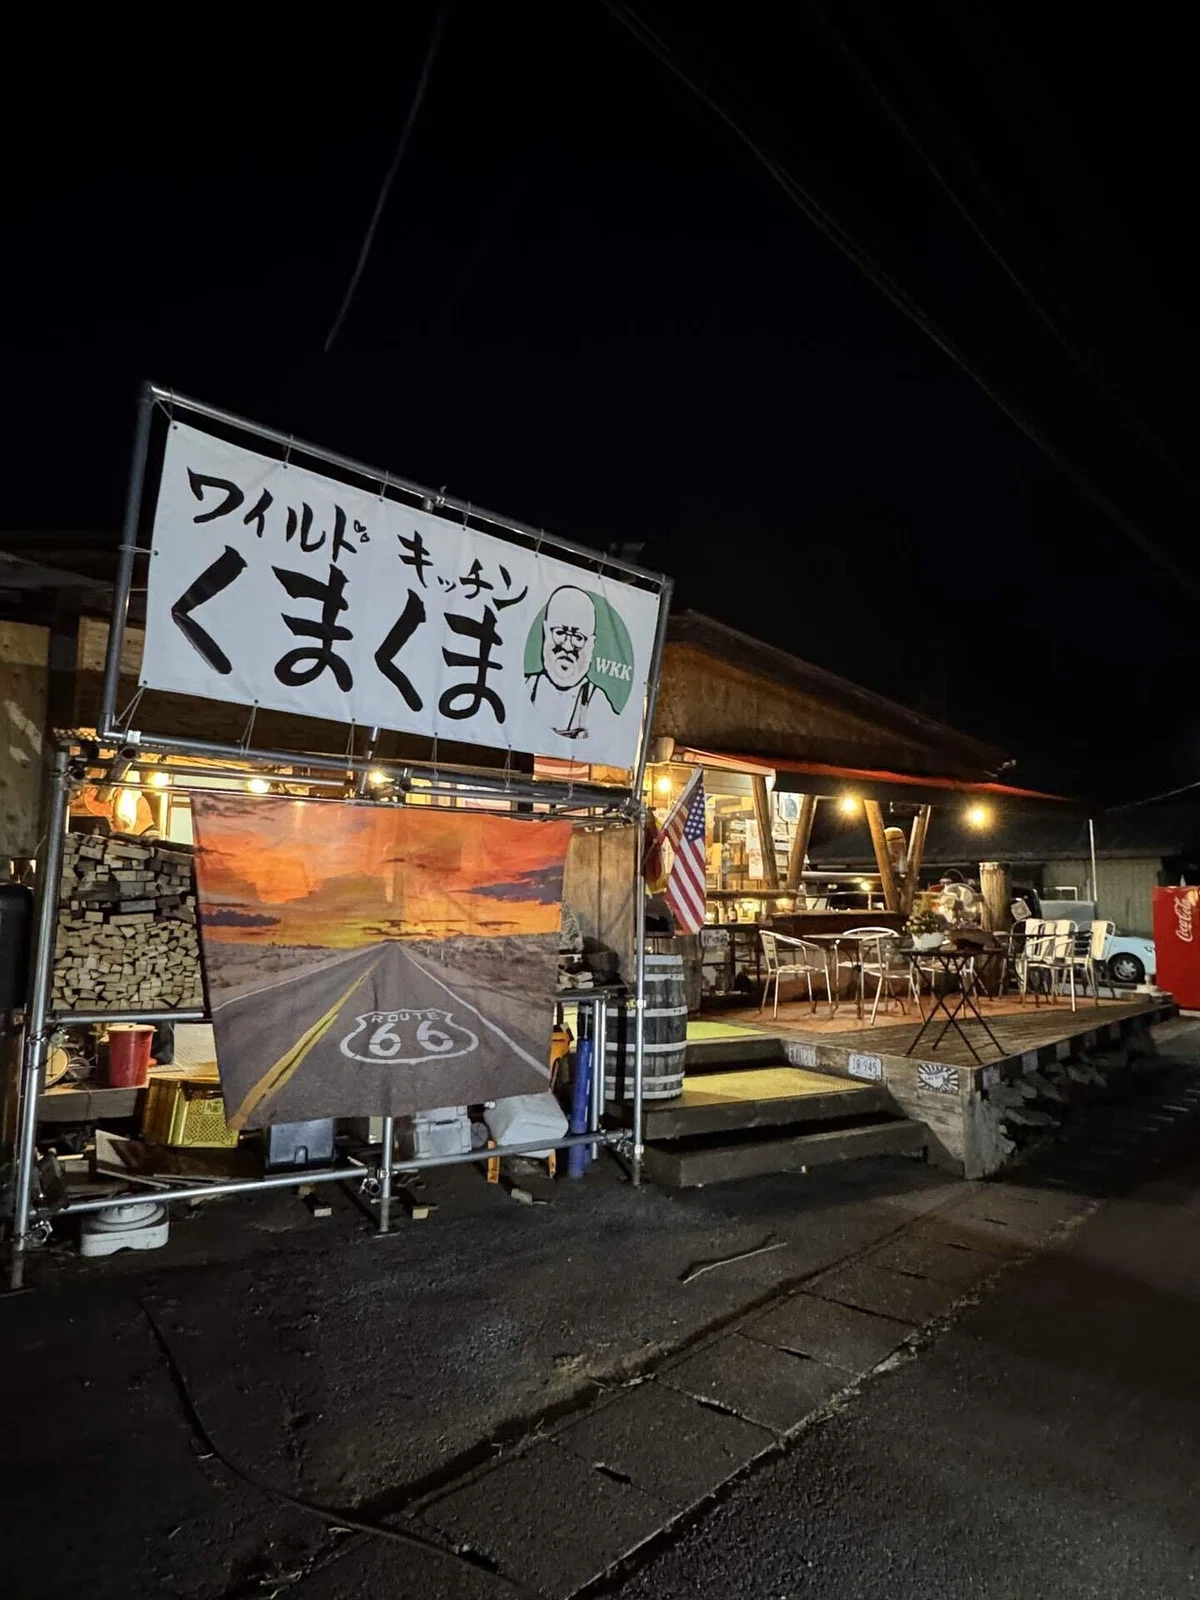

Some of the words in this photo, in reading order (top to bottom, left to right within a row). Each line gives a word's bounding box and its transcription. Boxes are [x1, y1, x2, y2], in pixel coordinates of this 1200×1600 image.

[187, 466, 370, 562] ワイルド
[398, 531, 528, 611] キッチン
[171, 545, 505, 724] くまくま
[595, 657, 632, 681] WKK
[371, 1011, 440, 1023] ROUTE
[368, 1020, 454, 1057] 66
